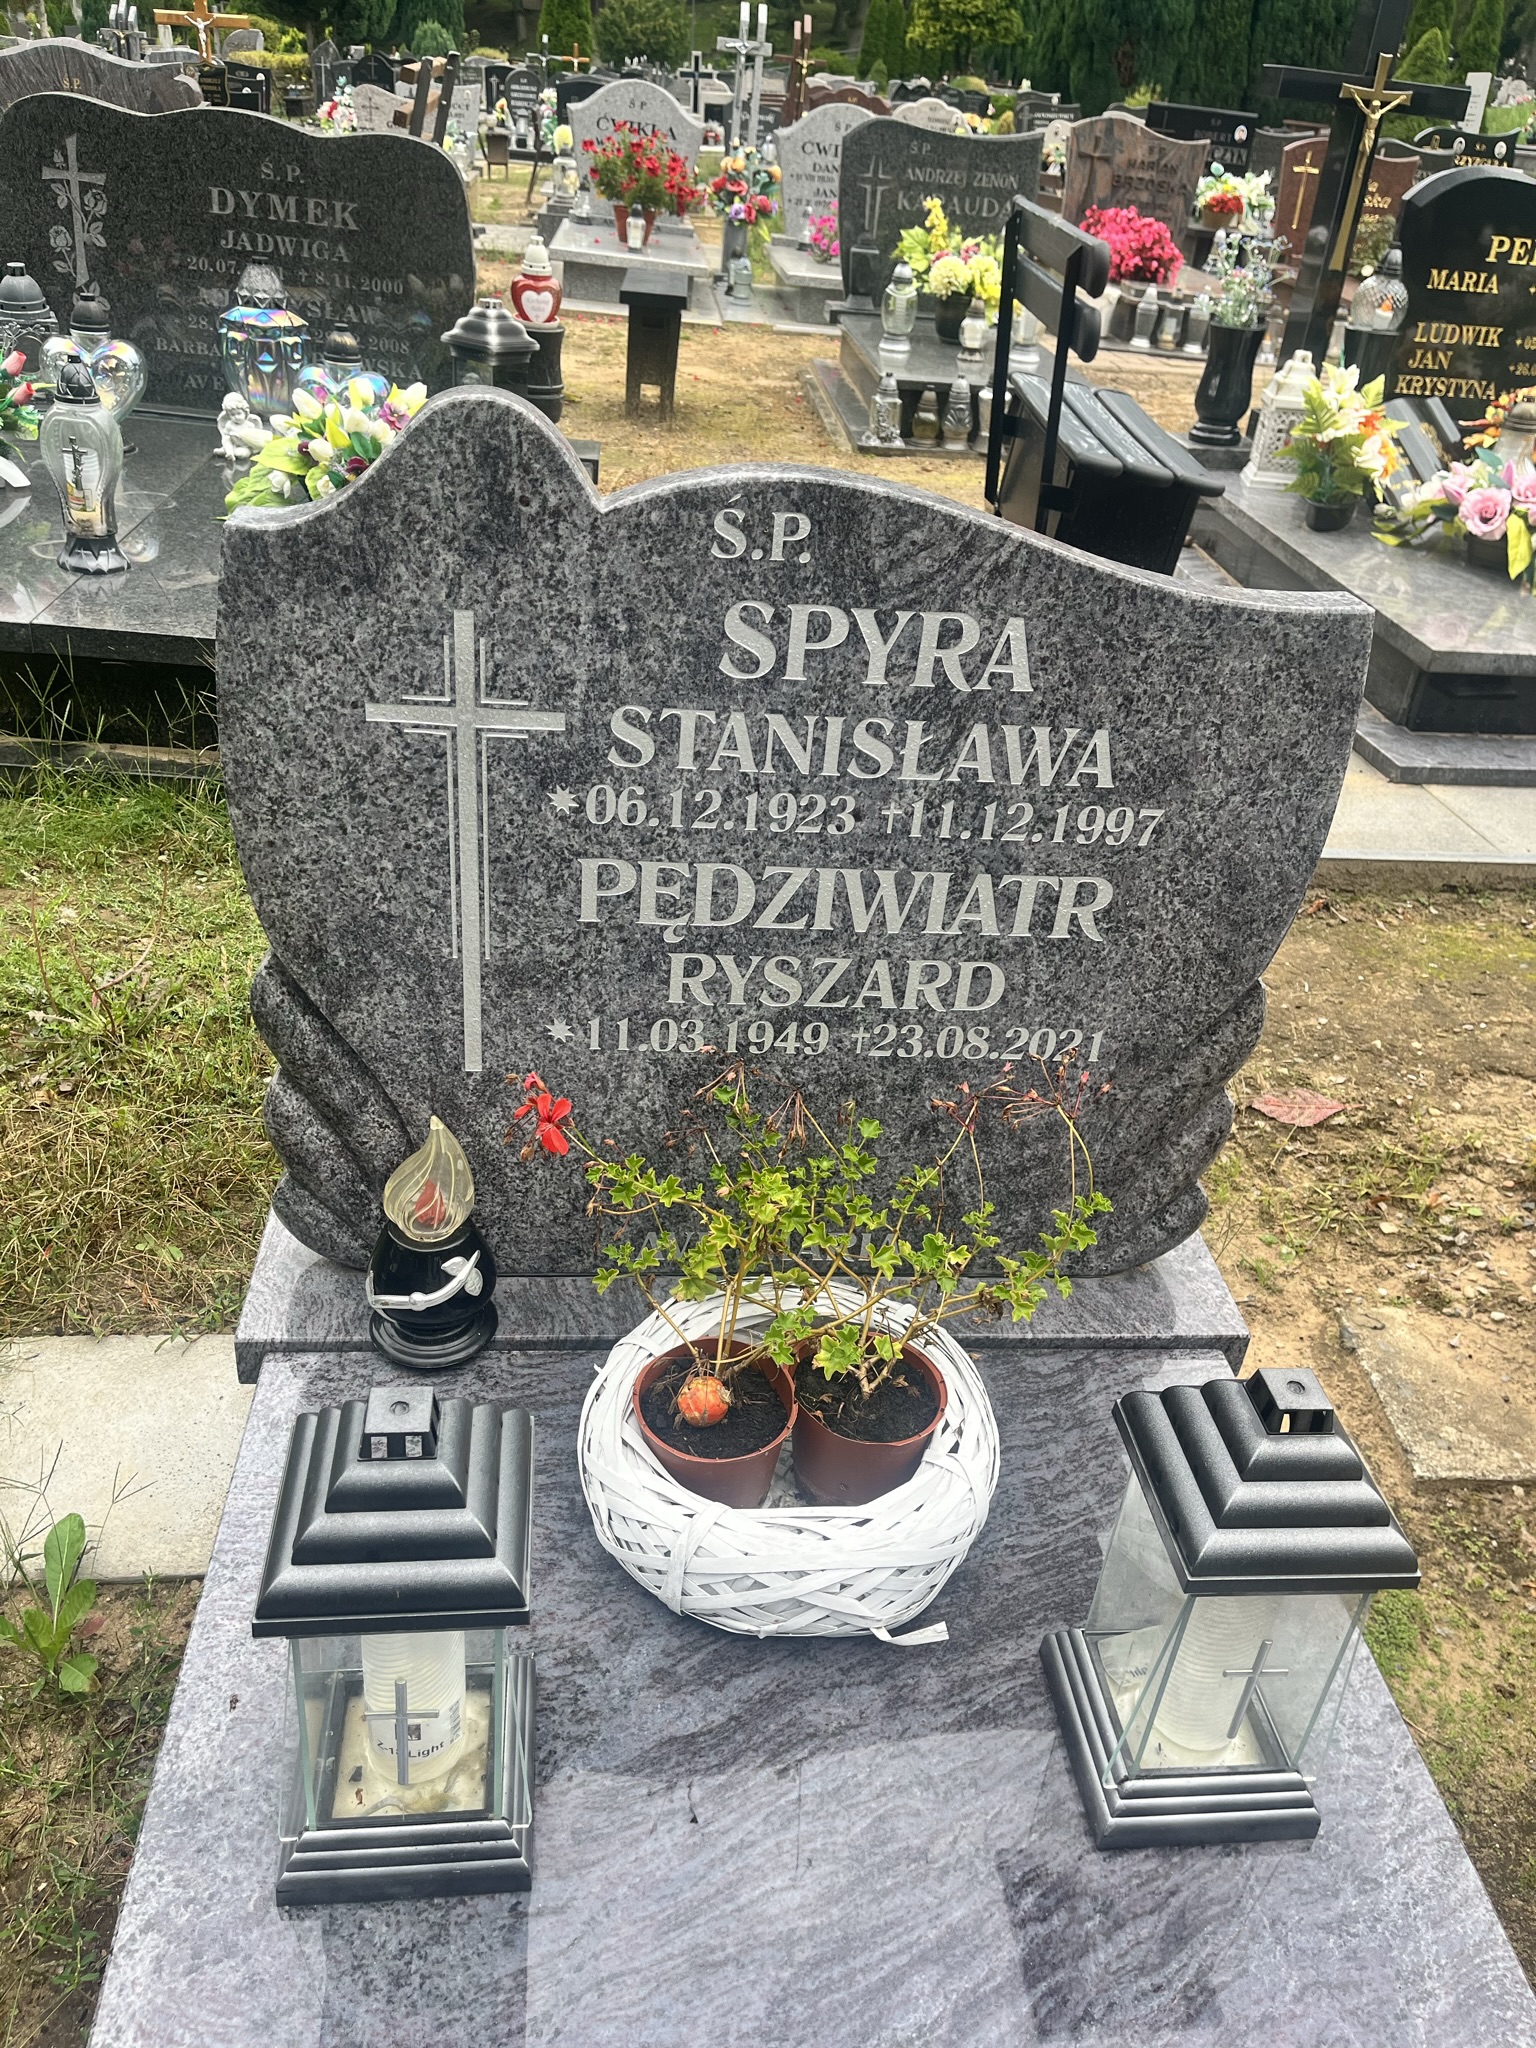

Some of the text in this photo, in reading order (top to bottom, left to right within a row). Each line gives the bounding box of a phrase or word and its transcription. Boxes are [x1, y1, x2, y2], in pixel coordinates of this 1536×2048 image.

[904, 167, 967, 189] ANDRZEJ
[208, 186, 360, 231] DYMEK
[220, 229, 350, 263] JADWIGA
[1485, 235, 1536, 266] PE
[1426, 268, 1499, 294] MARIA
[1413, 321, 1504, 348] LUDWIK
[1408, 349, 1454, 370] JAN
[1394, 374, 1496, 400] KRYSTYNA
[718, 600, 1034, 693] SPYRA
[606, 704, 1115, 789] STANISŁAWA
[585, 784, 856, 835] 06.12.1923
[576, 857, 1113, 943] PĘDZIWIATR
[666, 952, 1007, 1013] RYSZARD
[408, 1741, 445, 1758] Light
